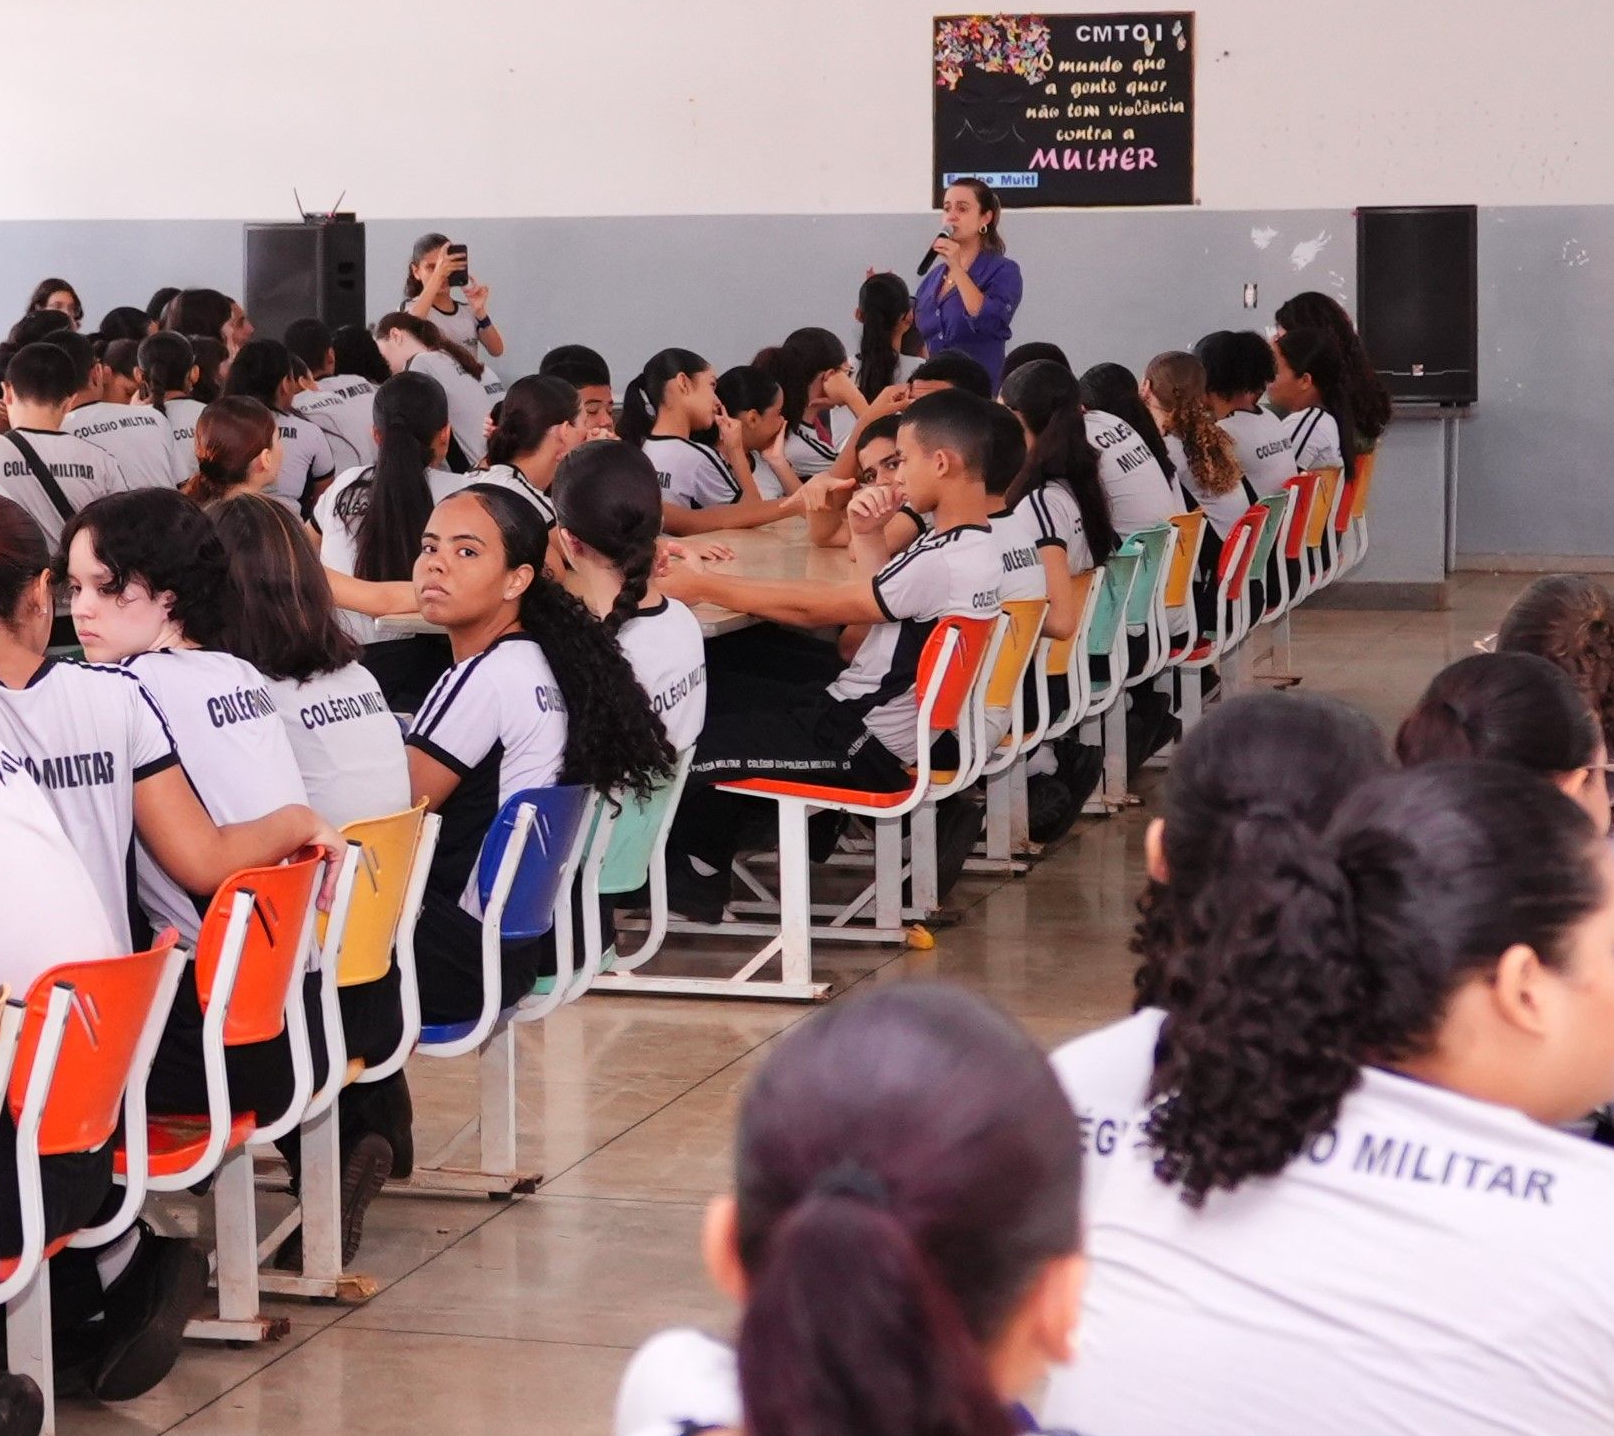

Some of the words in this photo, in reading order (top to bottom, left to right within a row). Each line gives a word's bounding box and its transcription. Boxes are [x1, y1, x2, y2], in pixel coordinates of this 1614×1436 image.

[1058, 56, 1123, 74] mundo
[1133, 57, 1166, 75] que
[1045, 83, 1057, 95] a
[1070, 78, 1117, 99] gente
[1126, 79, 1167, 99] quer
[1026, 104, 1059, 119] não
[1067, 103, 1100, 118] tem
[1109, 97, 1185, 117] violência
[1056, 125, 1113, 142] contra
[1122, 129, 1135, 141] a
[1028, 147, 1158, 172] MULHER
[120, 415, 158, 428] MILITAR
[300, 695, 362, 730] COLÉGIO
[1354, 1130, 1556, 1206] MILITAR
